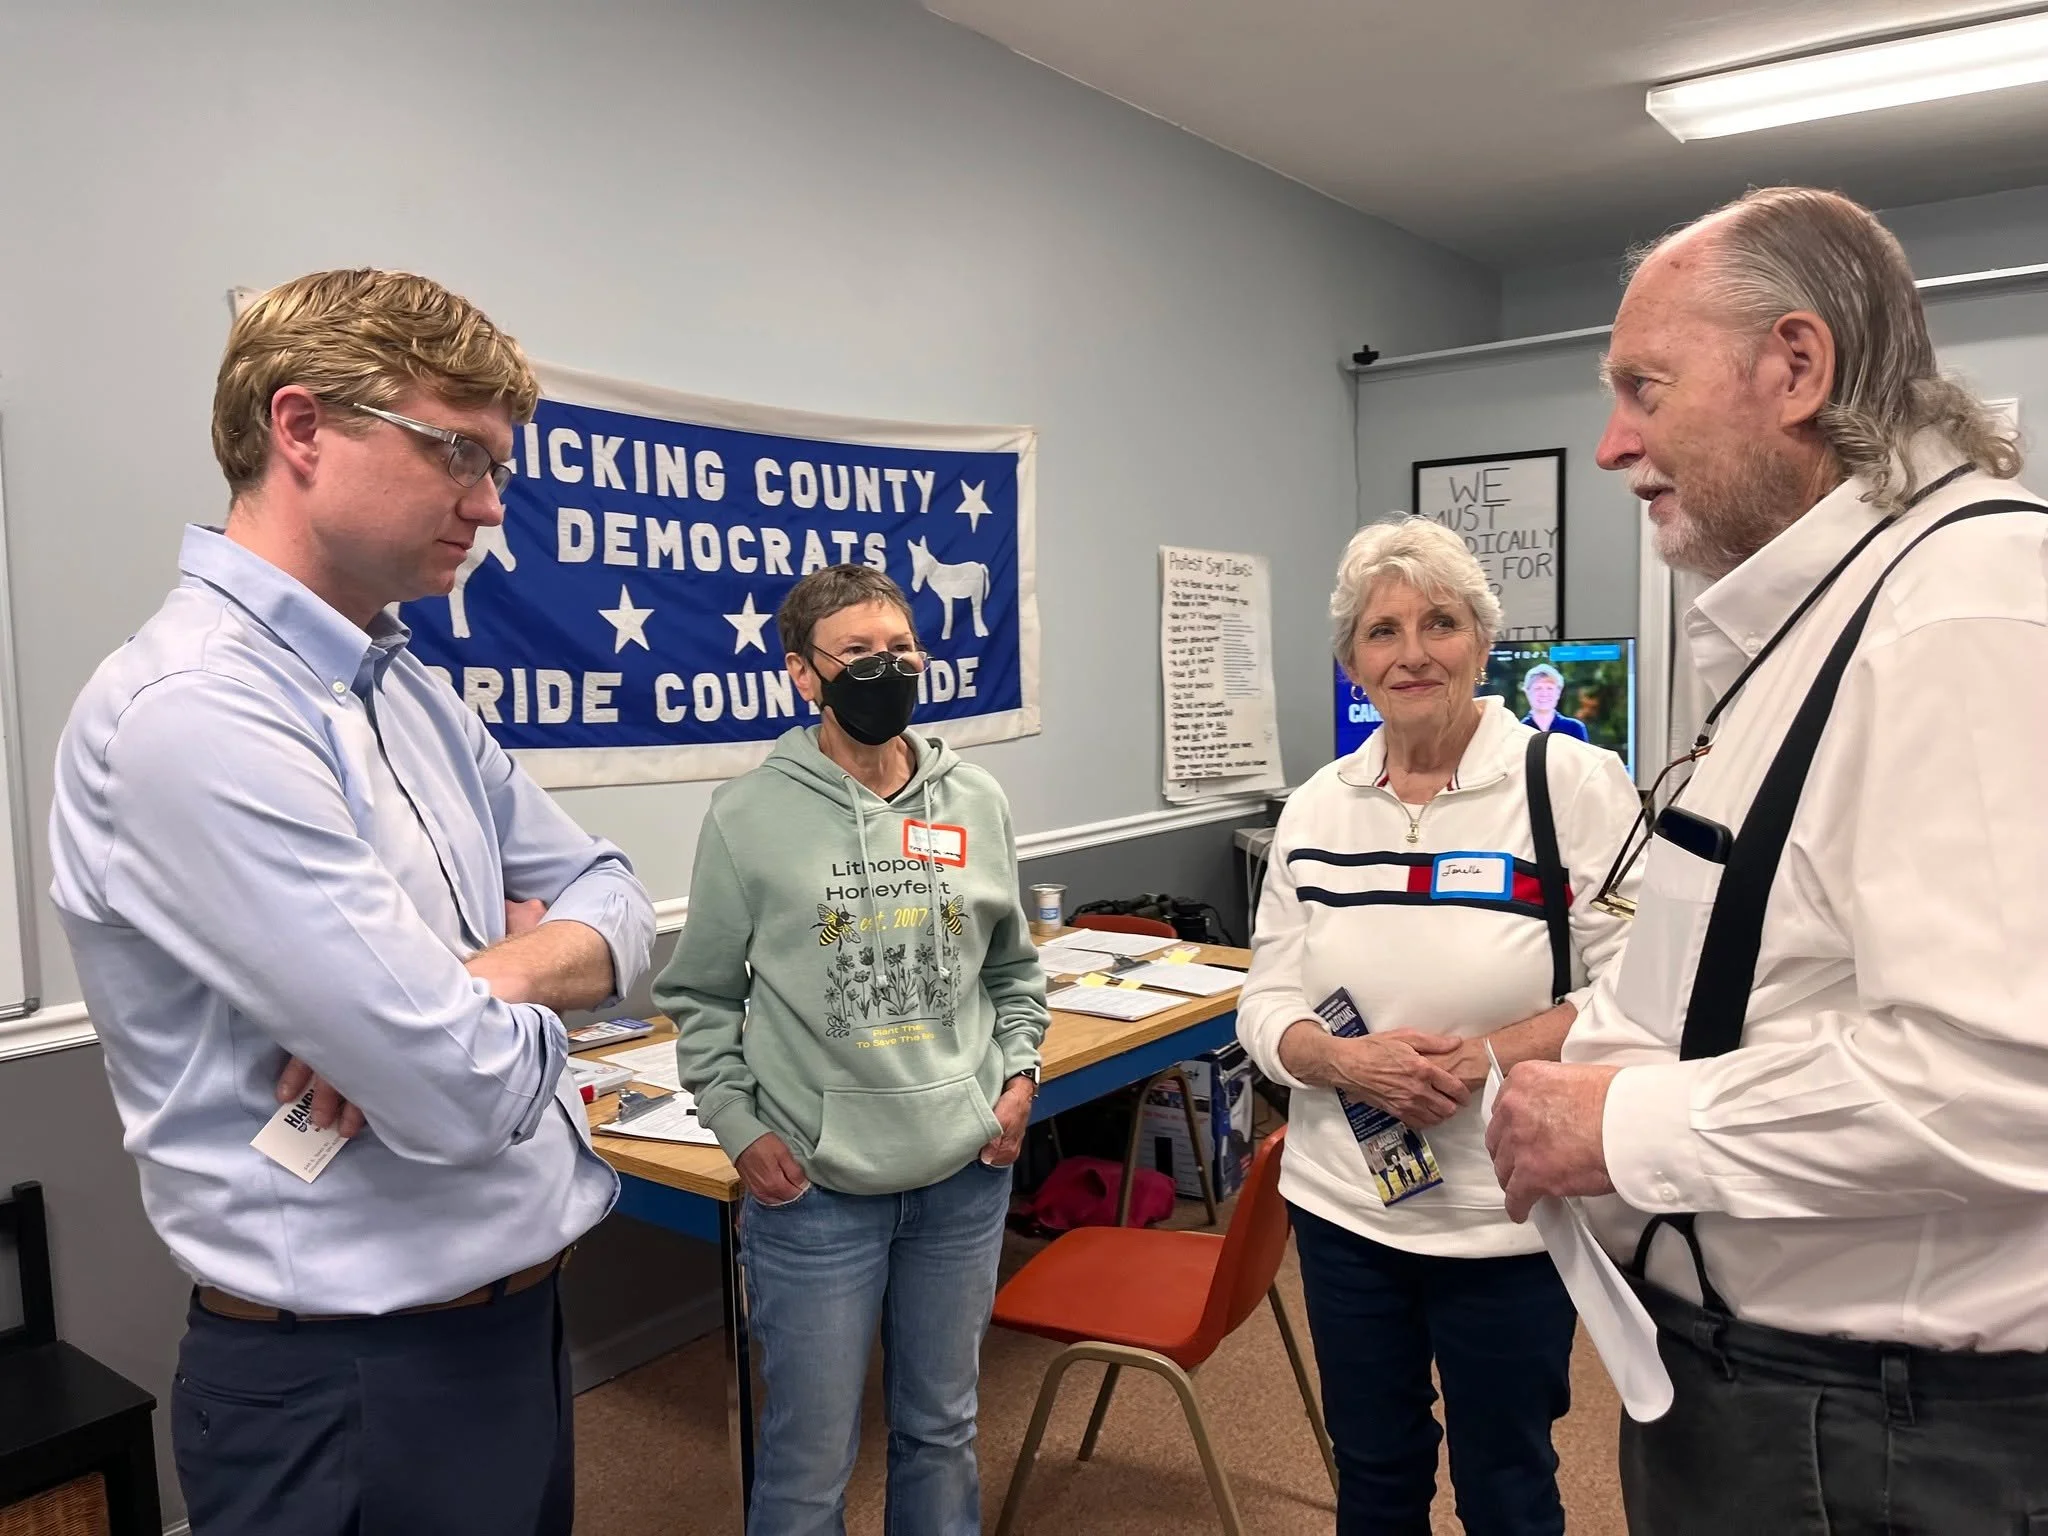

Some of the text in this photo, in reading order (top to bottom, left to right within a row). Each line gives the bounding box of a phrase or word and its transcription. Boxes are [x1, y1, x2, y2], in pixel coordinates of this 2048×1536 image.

[502, 423, 935, 514] ICKING COUNTY
[1450, 467, 1512, 504] WE
[557, 507, 887, 576] DEMOCRATS
[1465, 527, 1560, 554] DICALLY
[1502, 553, 1554, 580] FOR
[424, 665, 623, 725] RIDE
[832, 858, 945, 878] Lithopolis
[894, 908, 928, 928] 2007
[856, 1041, 870, 1049] To
[872, 1037, 897, 1048] Save
[899, 1034, 920, 1043] The
[872, 1026, 900, 1037] Plant
